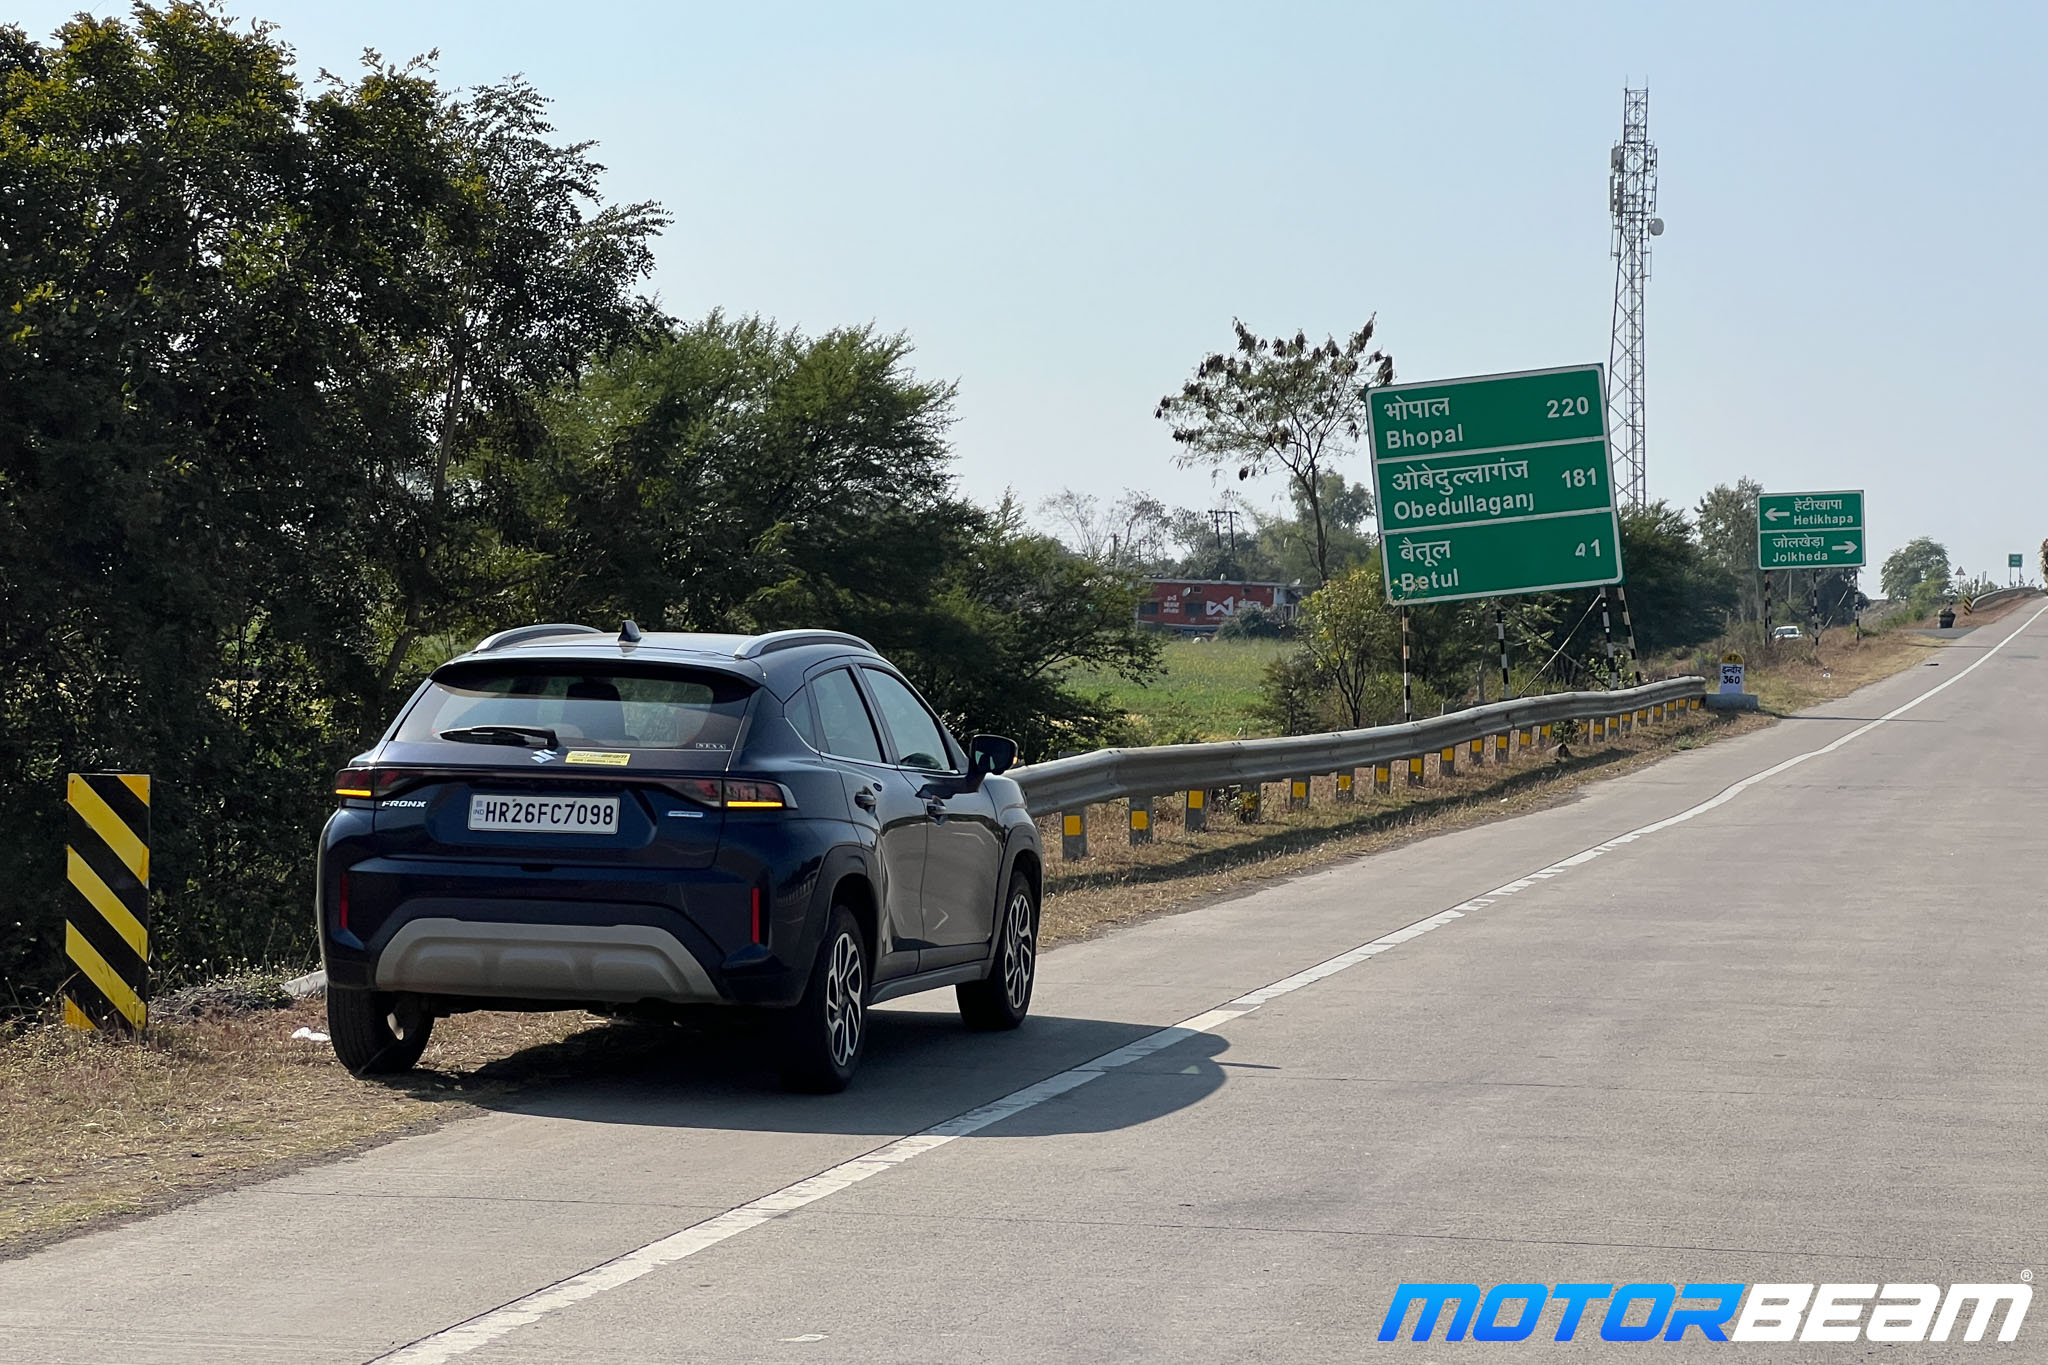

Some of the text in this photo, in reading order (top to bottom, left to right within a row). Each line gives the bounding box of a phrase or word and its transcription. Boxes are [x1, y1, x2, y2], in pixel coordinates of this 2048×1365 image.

[1384, 395, 1450, 421] भोपाल
[1546, 396, 1590, 419] 220
[1386, 424, 1464, 449] Bhopal
[1391, 458, 1529, 495] ओबेदुल्लागंज
[1561, 467, 1598, 489] 181
[1393, 493, 1535, 520] Obedullaganj
[1793, 496, 1843, 512] हेटीखापा
[1793, 514, 1854, 526] Hetikhapa
[1398, 536, 1451, 568] बैतूल
[1575, 539, 1602, 558] 41
[1772, 551, 1829, 563] Jolkheda
[1400, 568, 1460, 592] Betul
[1722, 675, 1741, 685] 360
[381, 800, 427, 808] FRONX
[473, 808, 485, 816] IND
[485, 801, 614, 826] HR26FC7098
